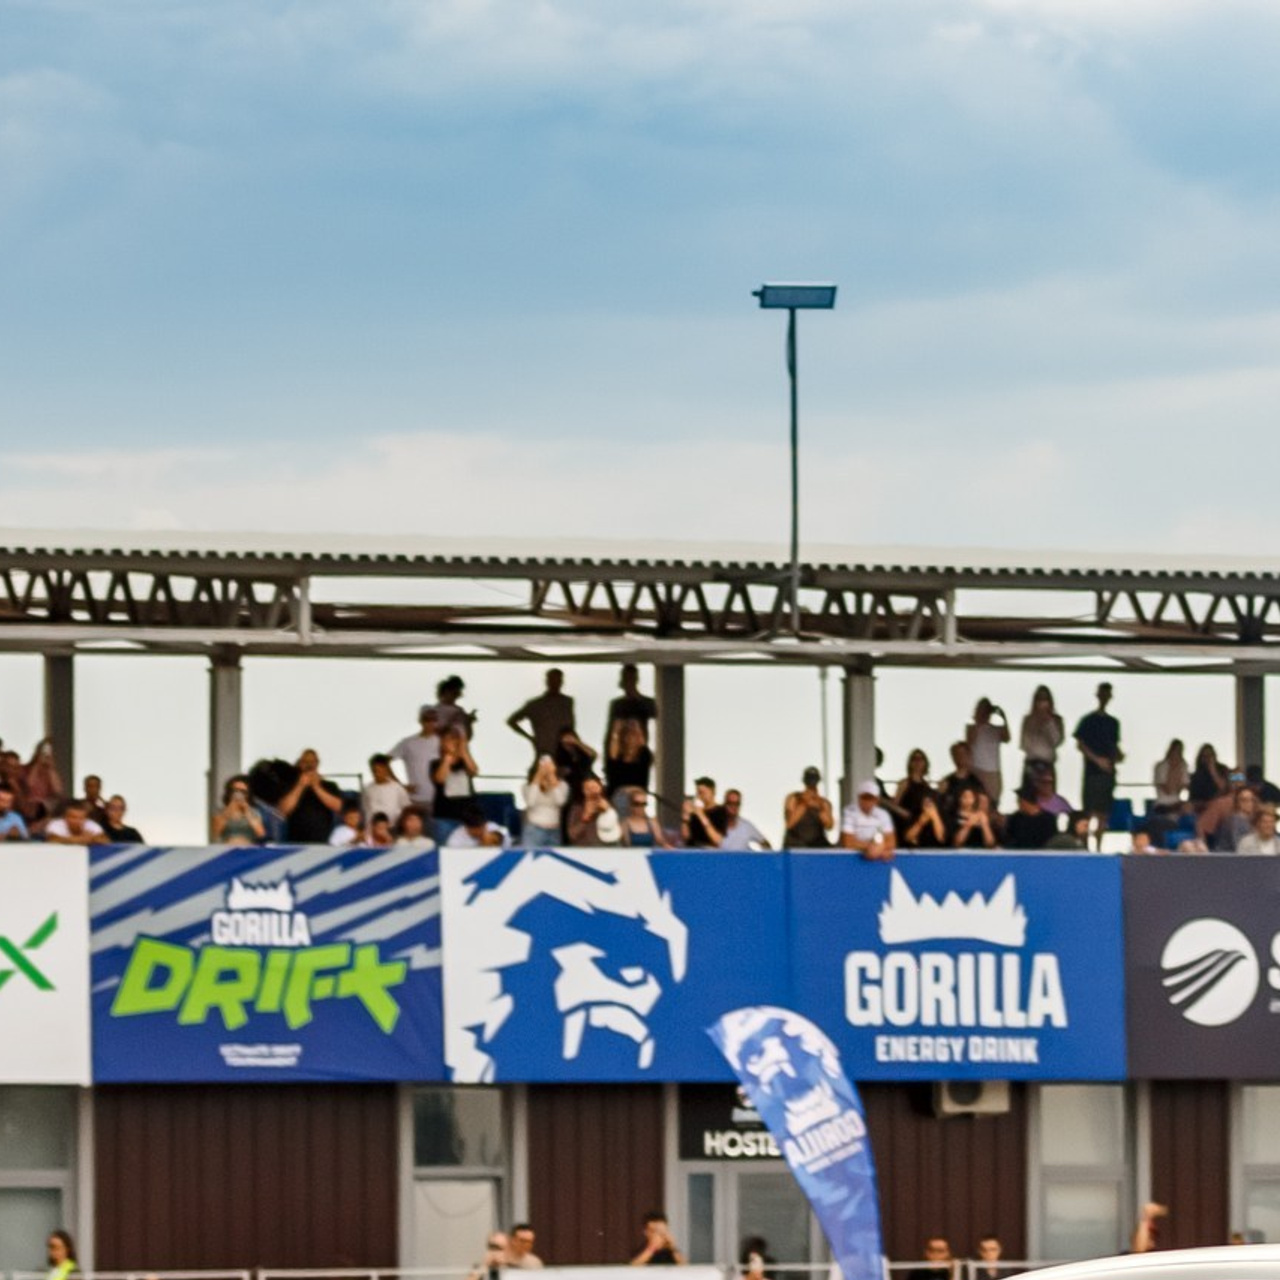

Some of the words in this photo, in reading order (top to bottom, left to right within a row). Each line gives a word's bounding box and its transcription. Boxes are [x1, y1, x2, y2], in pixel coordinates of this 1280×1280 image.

[211, 912, 311, 946] GORILLA
[844, 950, 1068, 1029] GORILLA
[875, 1035, 965, 1063] ENERGY
[969, 1036, 1039, 1064] DRINK
